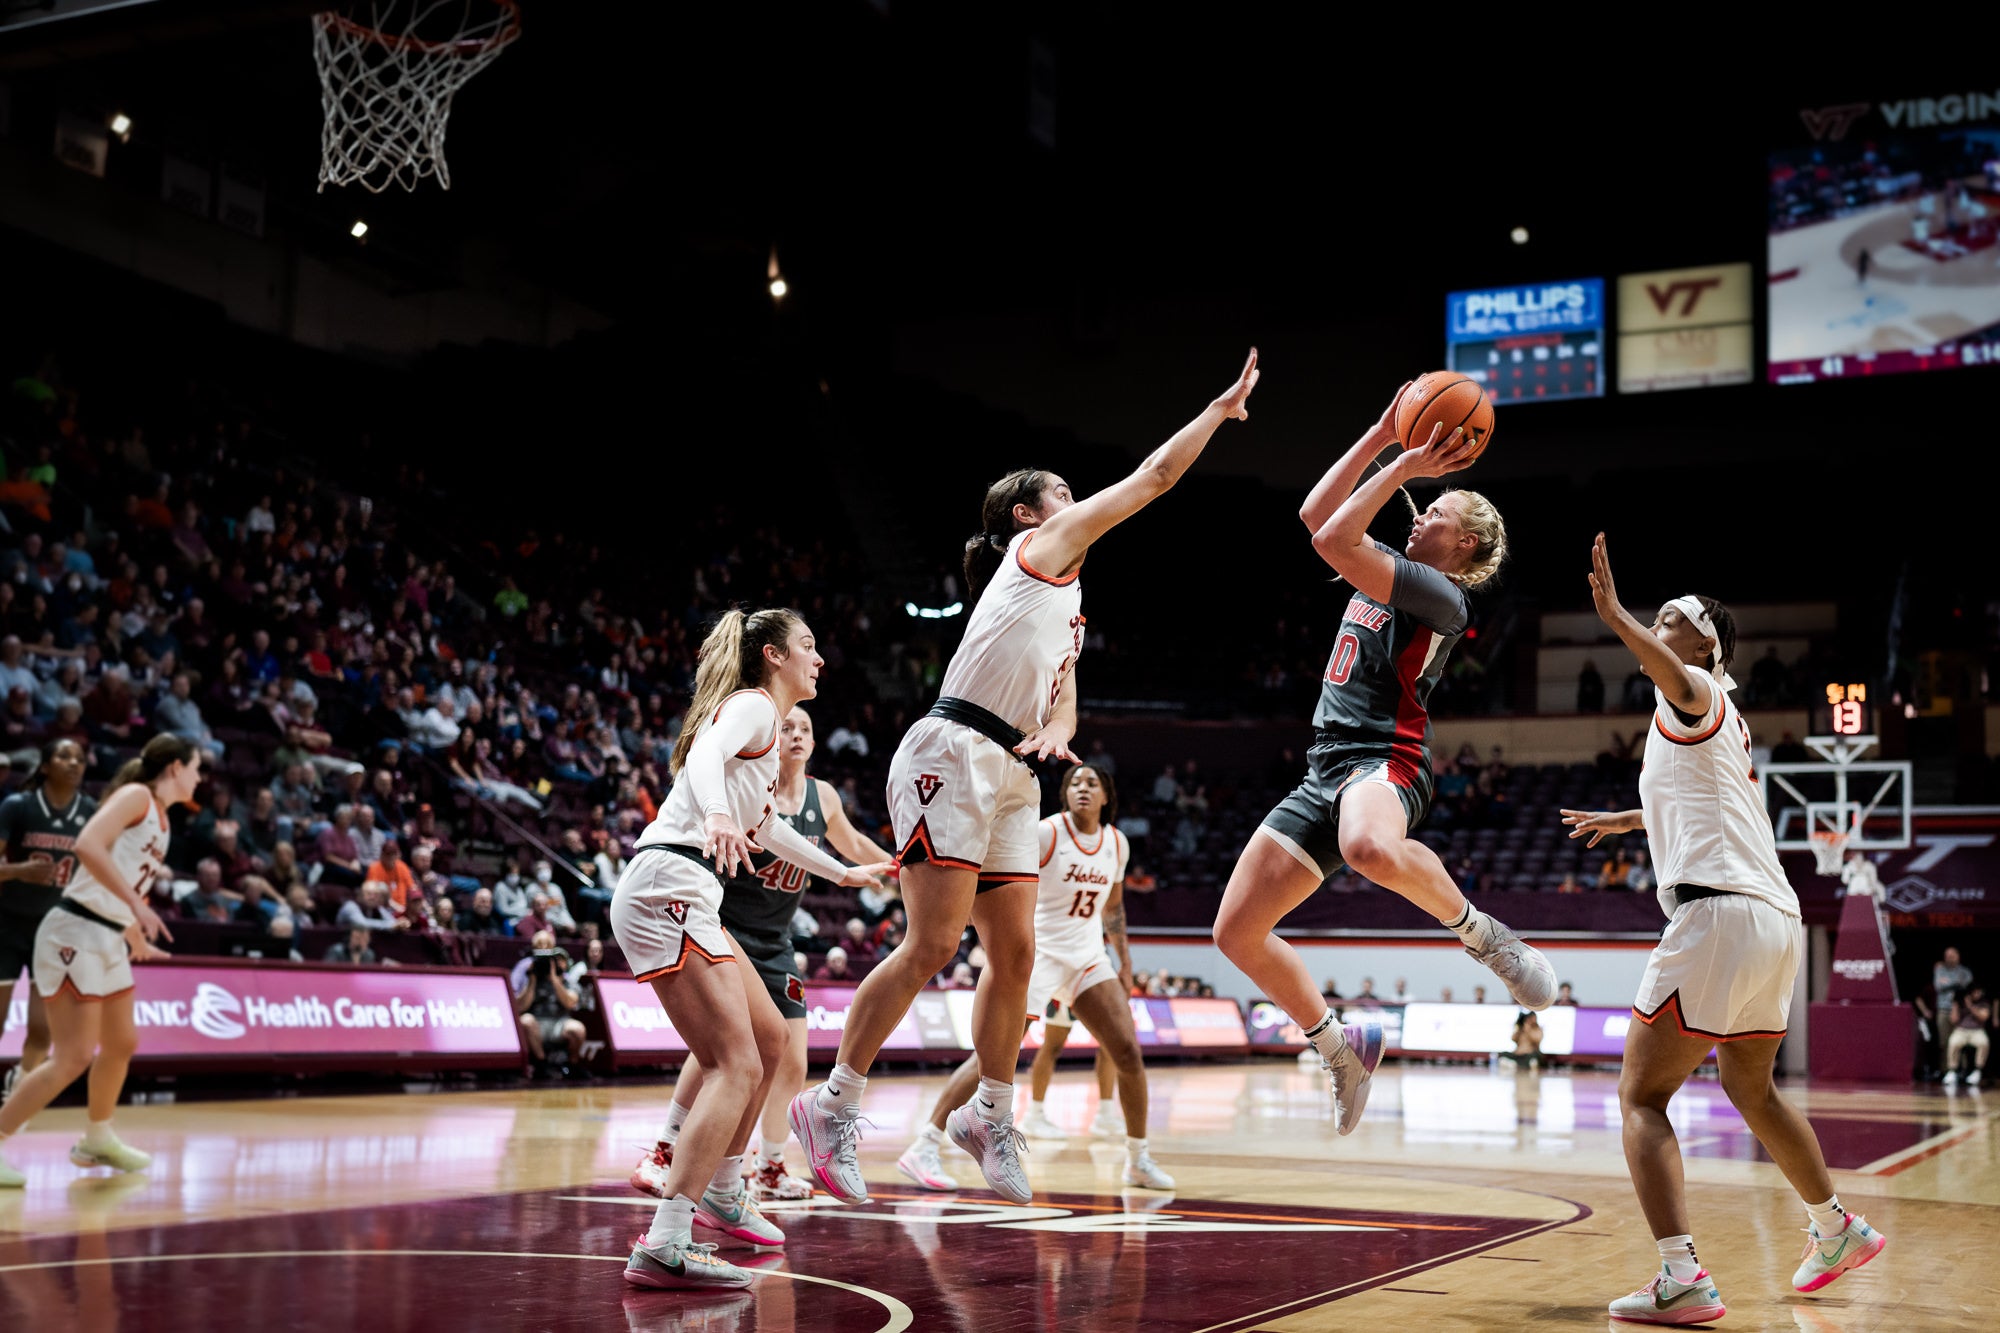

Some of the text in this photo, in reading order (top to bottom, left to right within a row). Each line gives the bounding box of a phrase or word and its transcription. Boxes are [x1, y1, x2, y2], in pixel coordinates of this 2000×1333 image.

[1465, 284, 1586, 318] PHILLIPS
[1644, 277, 1722, 317] VT
[1465, 308, 1585, 333] REAL ESTATE
[1833, 701, 1861, 735] 13
[757, 858, 807, 893] 40
[1062, 864, 1108, 885] Hokies
[1068, 890, 1099, 919] 13
[245, 996, 333, 1027] Health
[334, 997, 391, 1028] Care
[391, 997, 425, 1028] for
[427, 999, 503, 1028] Hokies
